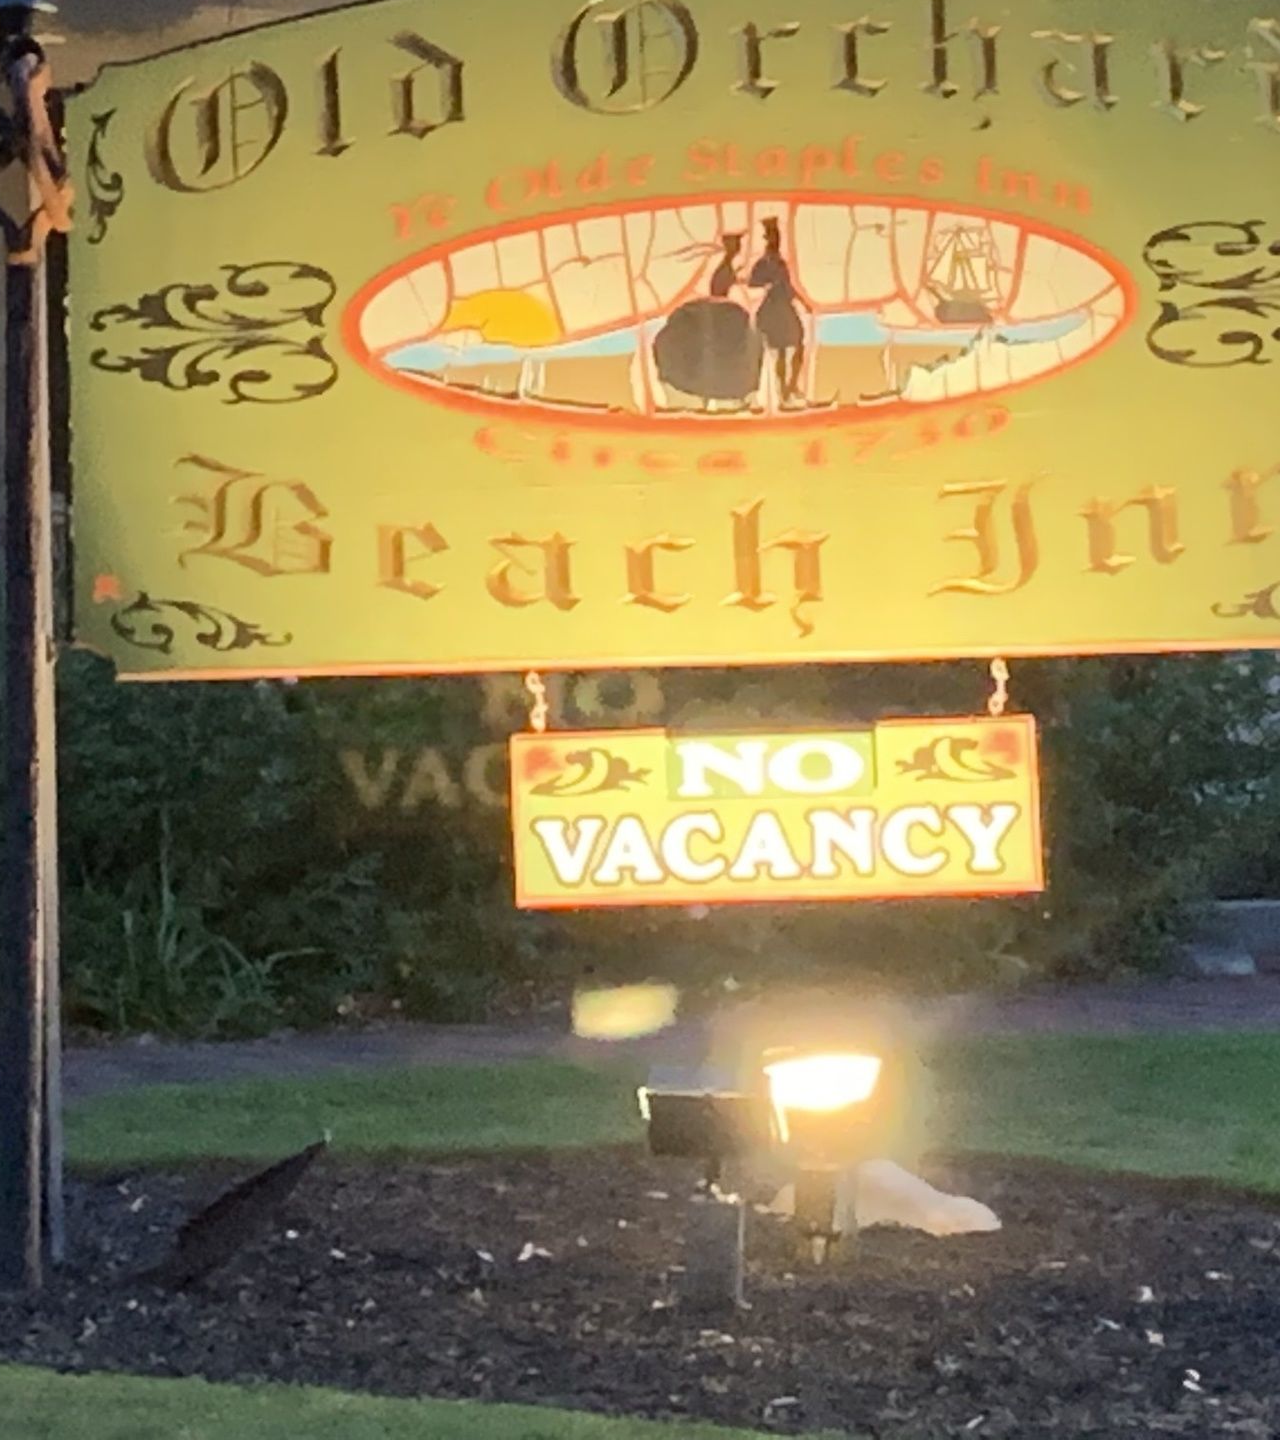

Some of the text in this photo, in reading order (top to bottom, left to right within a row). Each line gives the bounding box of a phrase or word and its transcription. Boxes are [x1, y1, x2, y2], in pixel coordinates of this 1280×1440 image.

[144, 30, 466, 193] Old
[484, 148, 655, 210] Olde
[682, 133, 944, 188] Staples
[977, 156, 1092, 215] Inn
[472, 424, 748, 474] Circa
[165, 452, 829, 638] Beach
[674, 739, 865, 797] NO
[531, 802, 1022, 886] VACANCY
